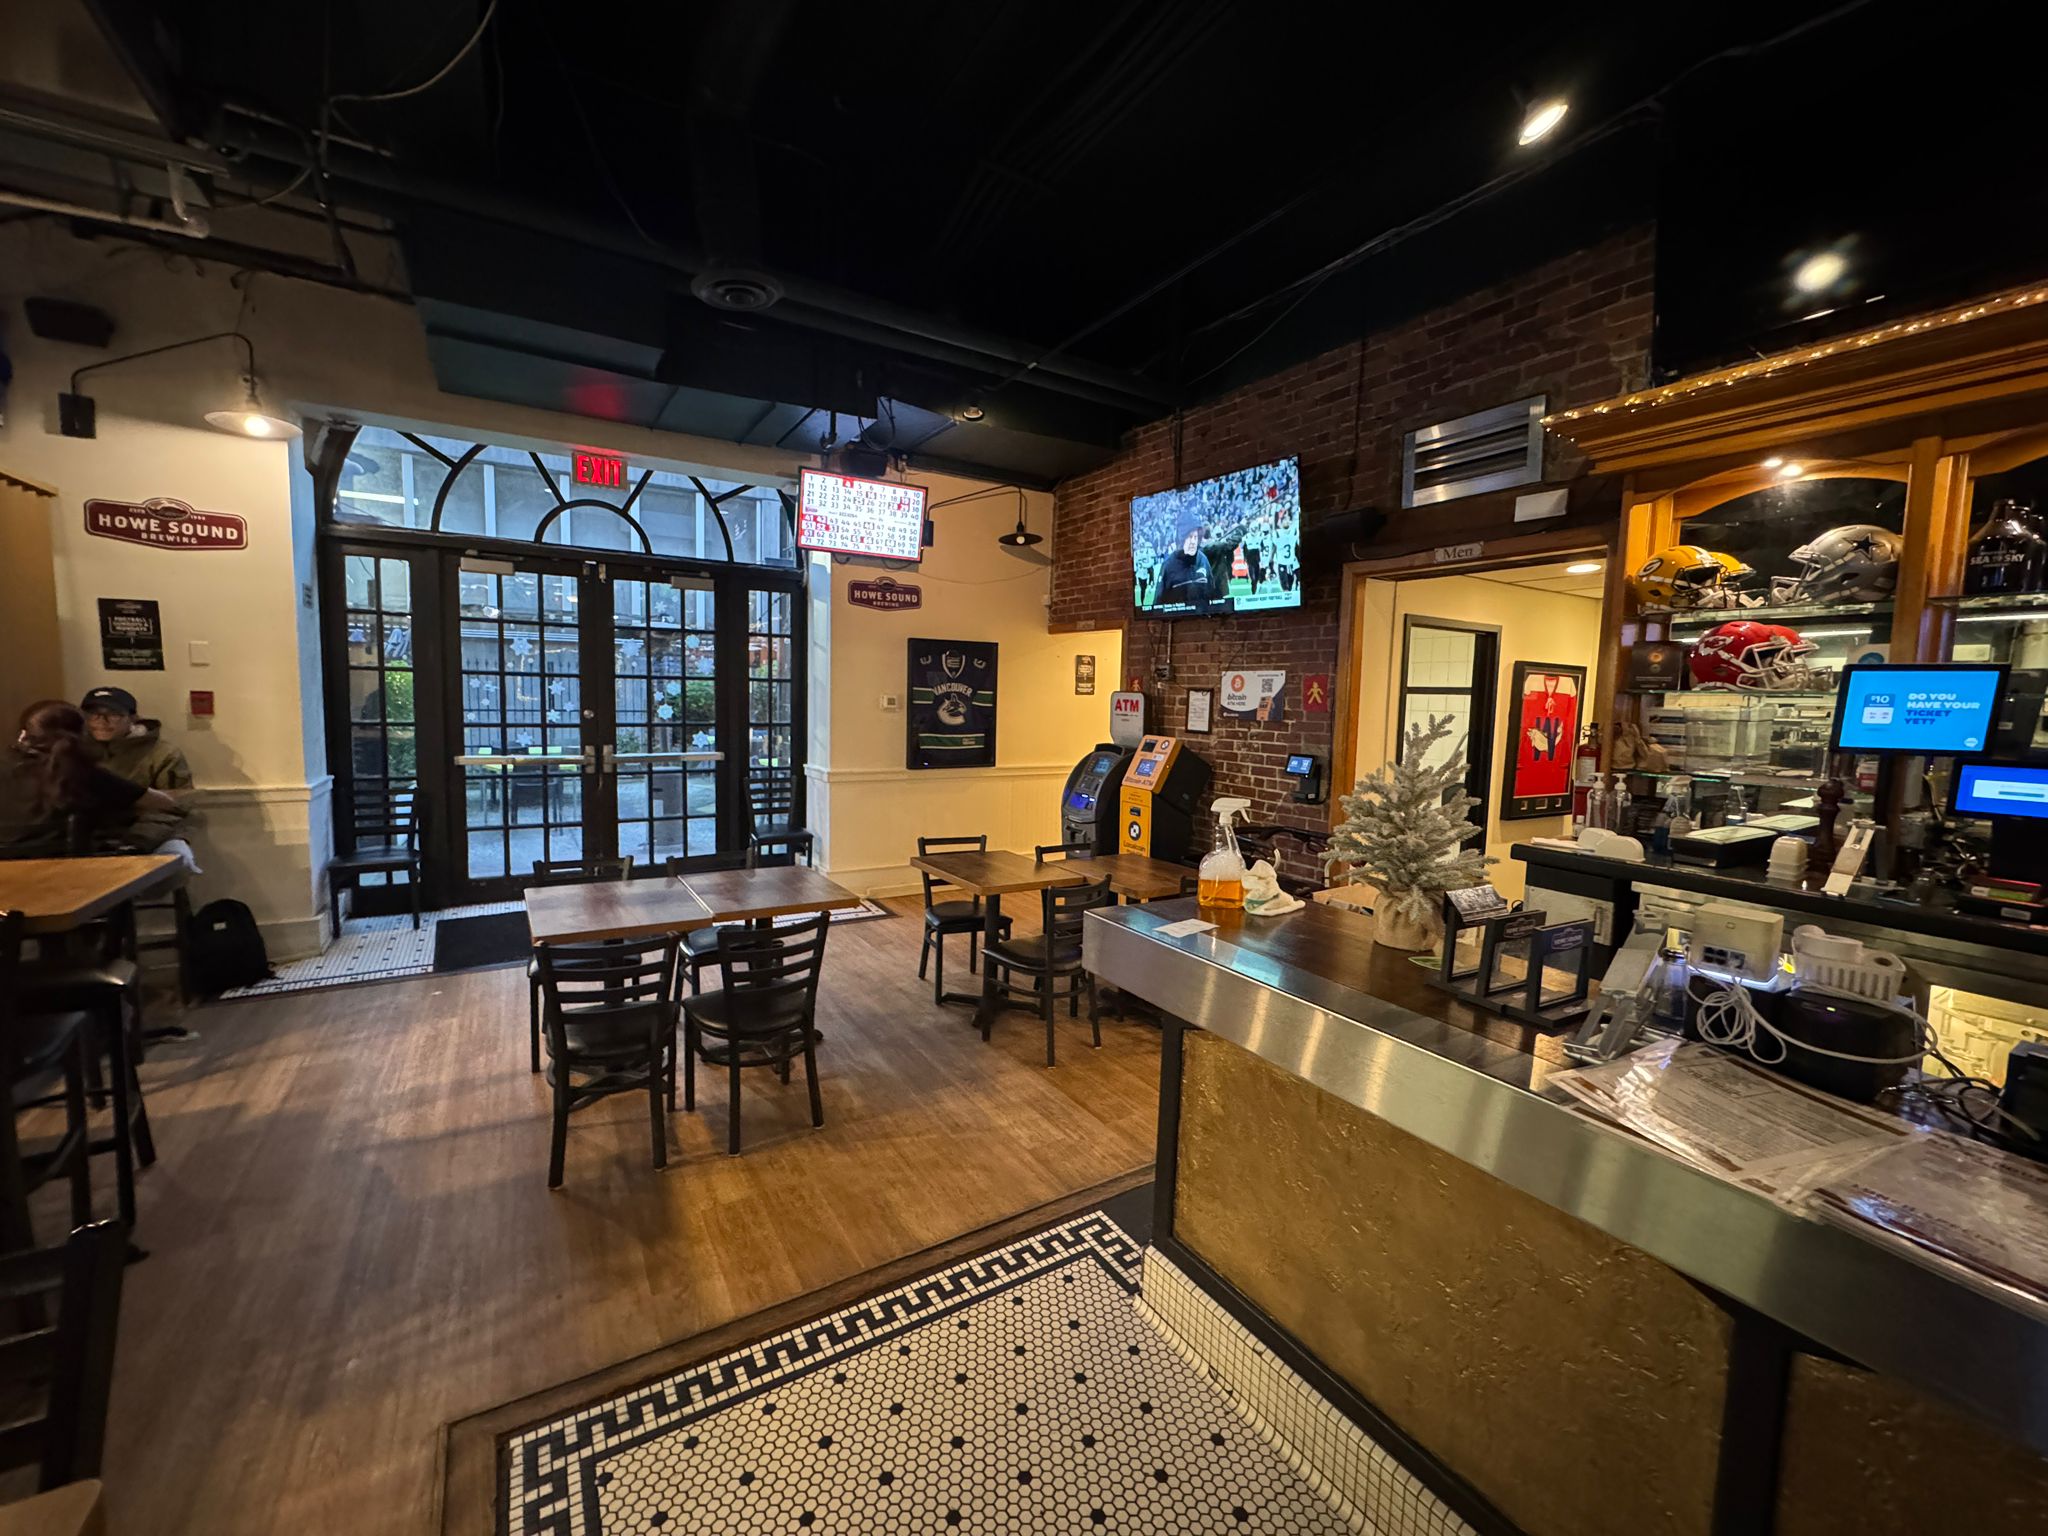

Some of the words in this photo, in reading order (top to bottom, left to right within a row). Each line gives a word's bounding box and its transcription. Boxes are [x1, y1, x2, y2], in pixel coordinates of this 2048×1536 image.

[577, 454, 622, 487] EXIT
[99, 513, 161, 531] HOWE
[168, 521, 238, 540] SOUND
[141, 532, 197, 544] BREWING
[1443, 548, 1473, 559] Men
[1970, 556, 1990, 565] SEA
[2004, 553, 2025, 562] SKY
[854, 590, 883, 600] HOWE
[885, 592, 918, 603] SOUND
[933, 682, 973, 697] VANCOUVER
[1929, 693, 1957, 701] YOU
[1115, 698, 1140, 712] ATM
[1907, 701, 1942, 709] HAVE
[1944, 701, 1981, 709] YOUR
[1905, 709, 1952, 717] TICKET
